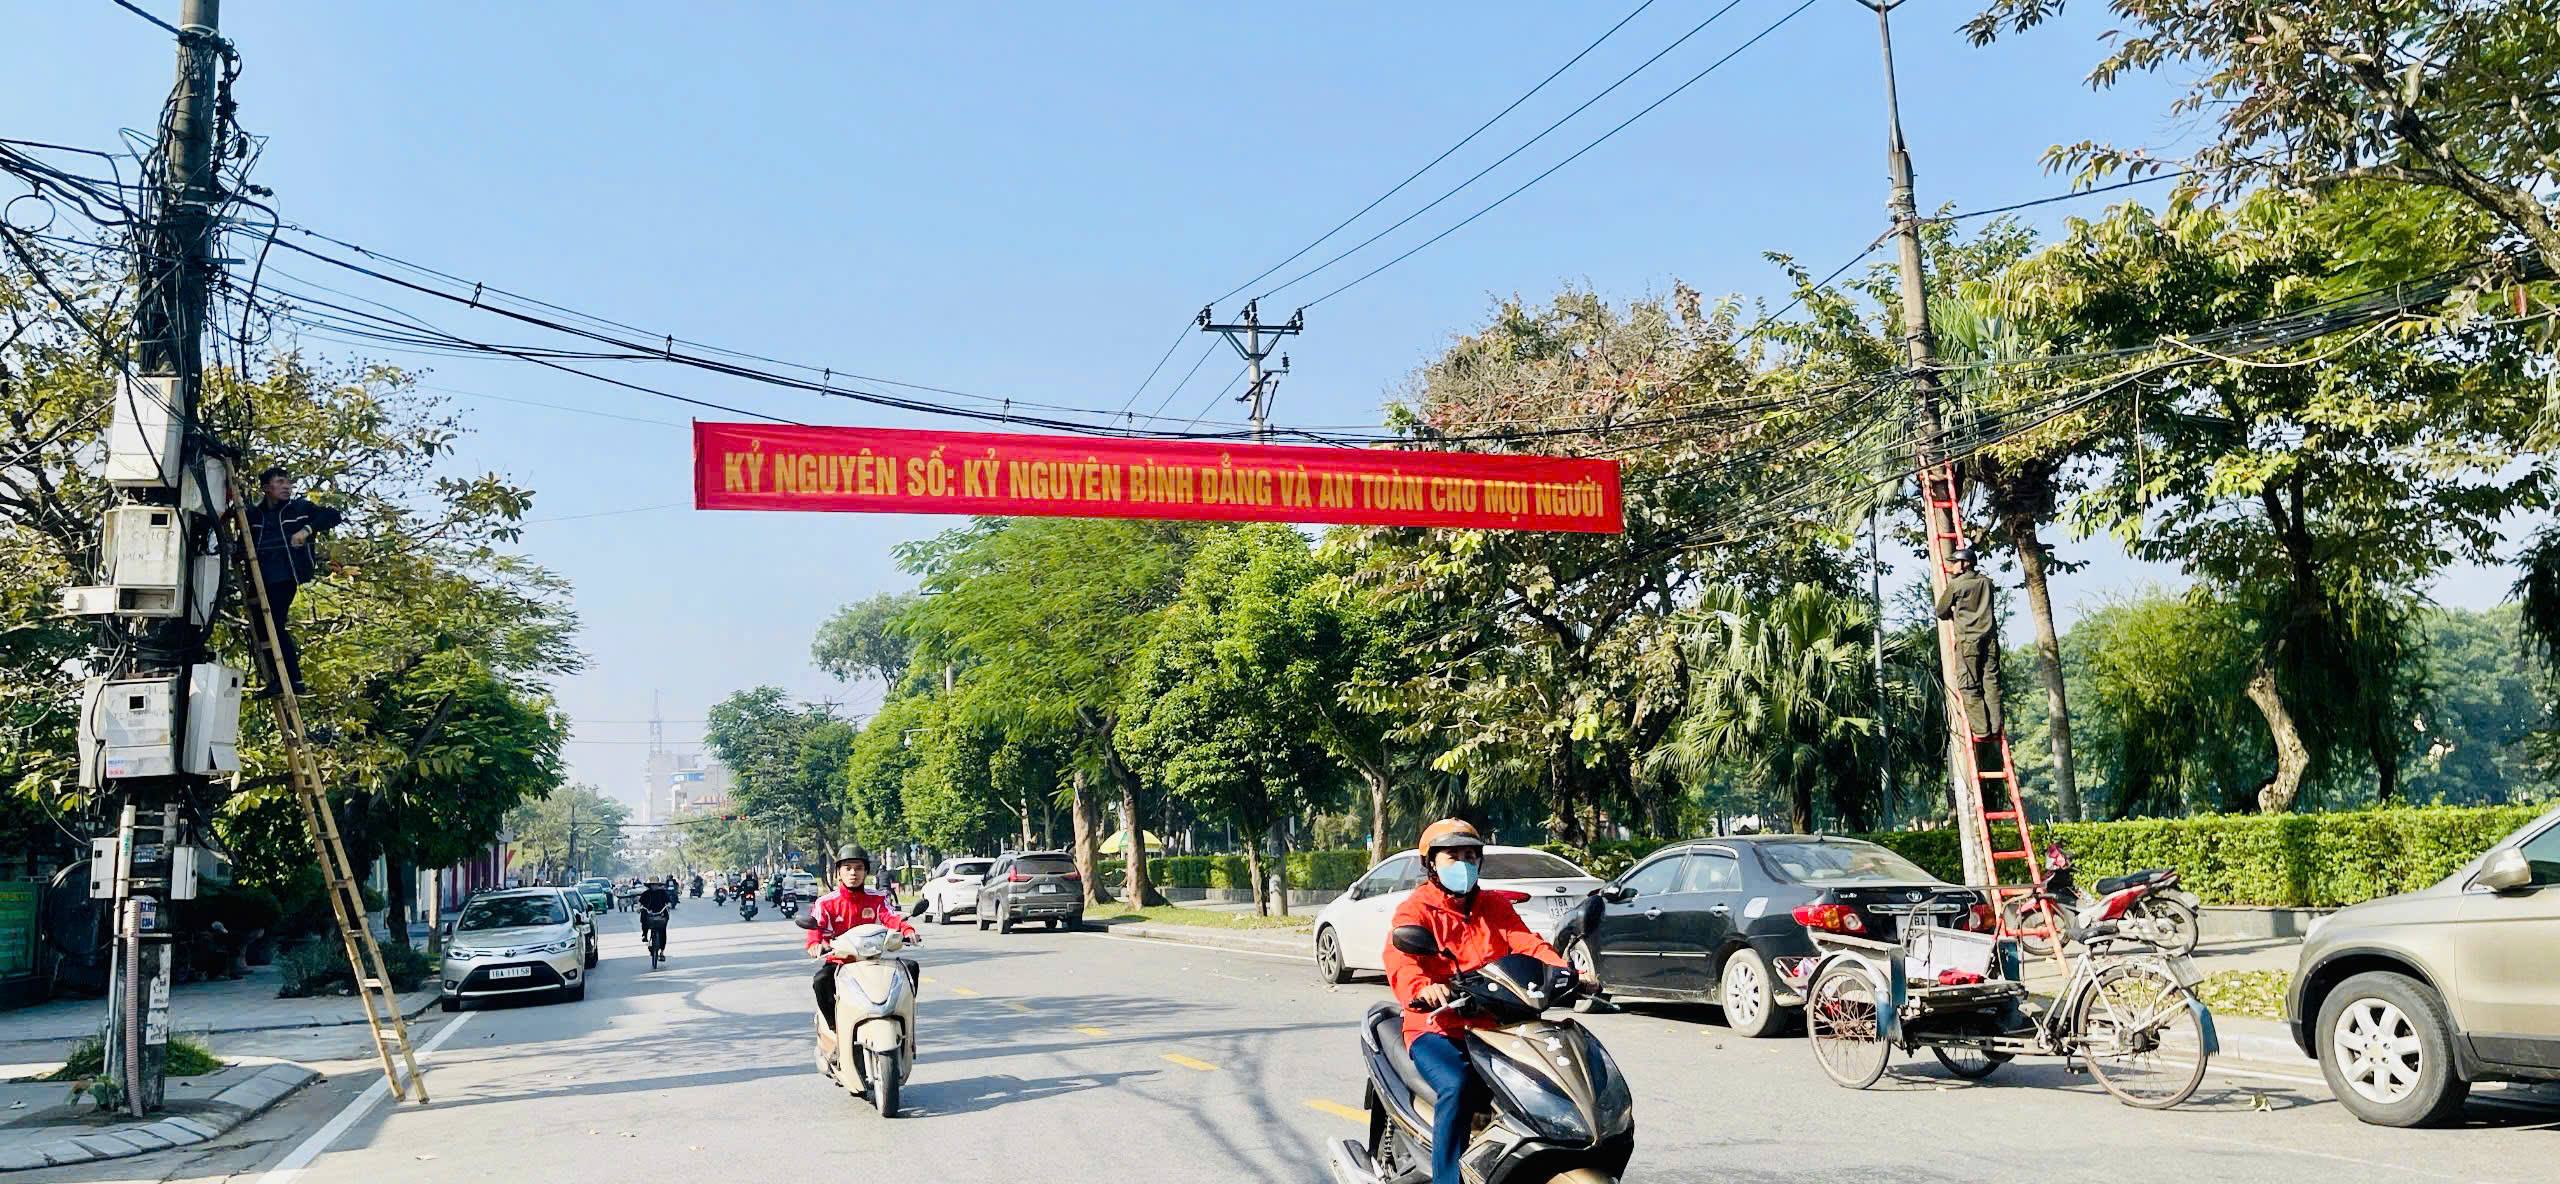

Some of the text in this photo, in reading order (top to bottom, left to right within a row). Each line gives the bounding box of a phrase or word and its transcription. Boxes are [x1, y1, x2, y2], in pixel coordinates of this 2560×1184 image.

[724, 440, 1604, 522] KỶ NGUYÊN SỐ: KỶ NGUYÊN BÌNH ĐẲNG VÀ AN TOÀN CHO MỌI NGƯỜI
[1554, 897, 1568, 907] 18A
